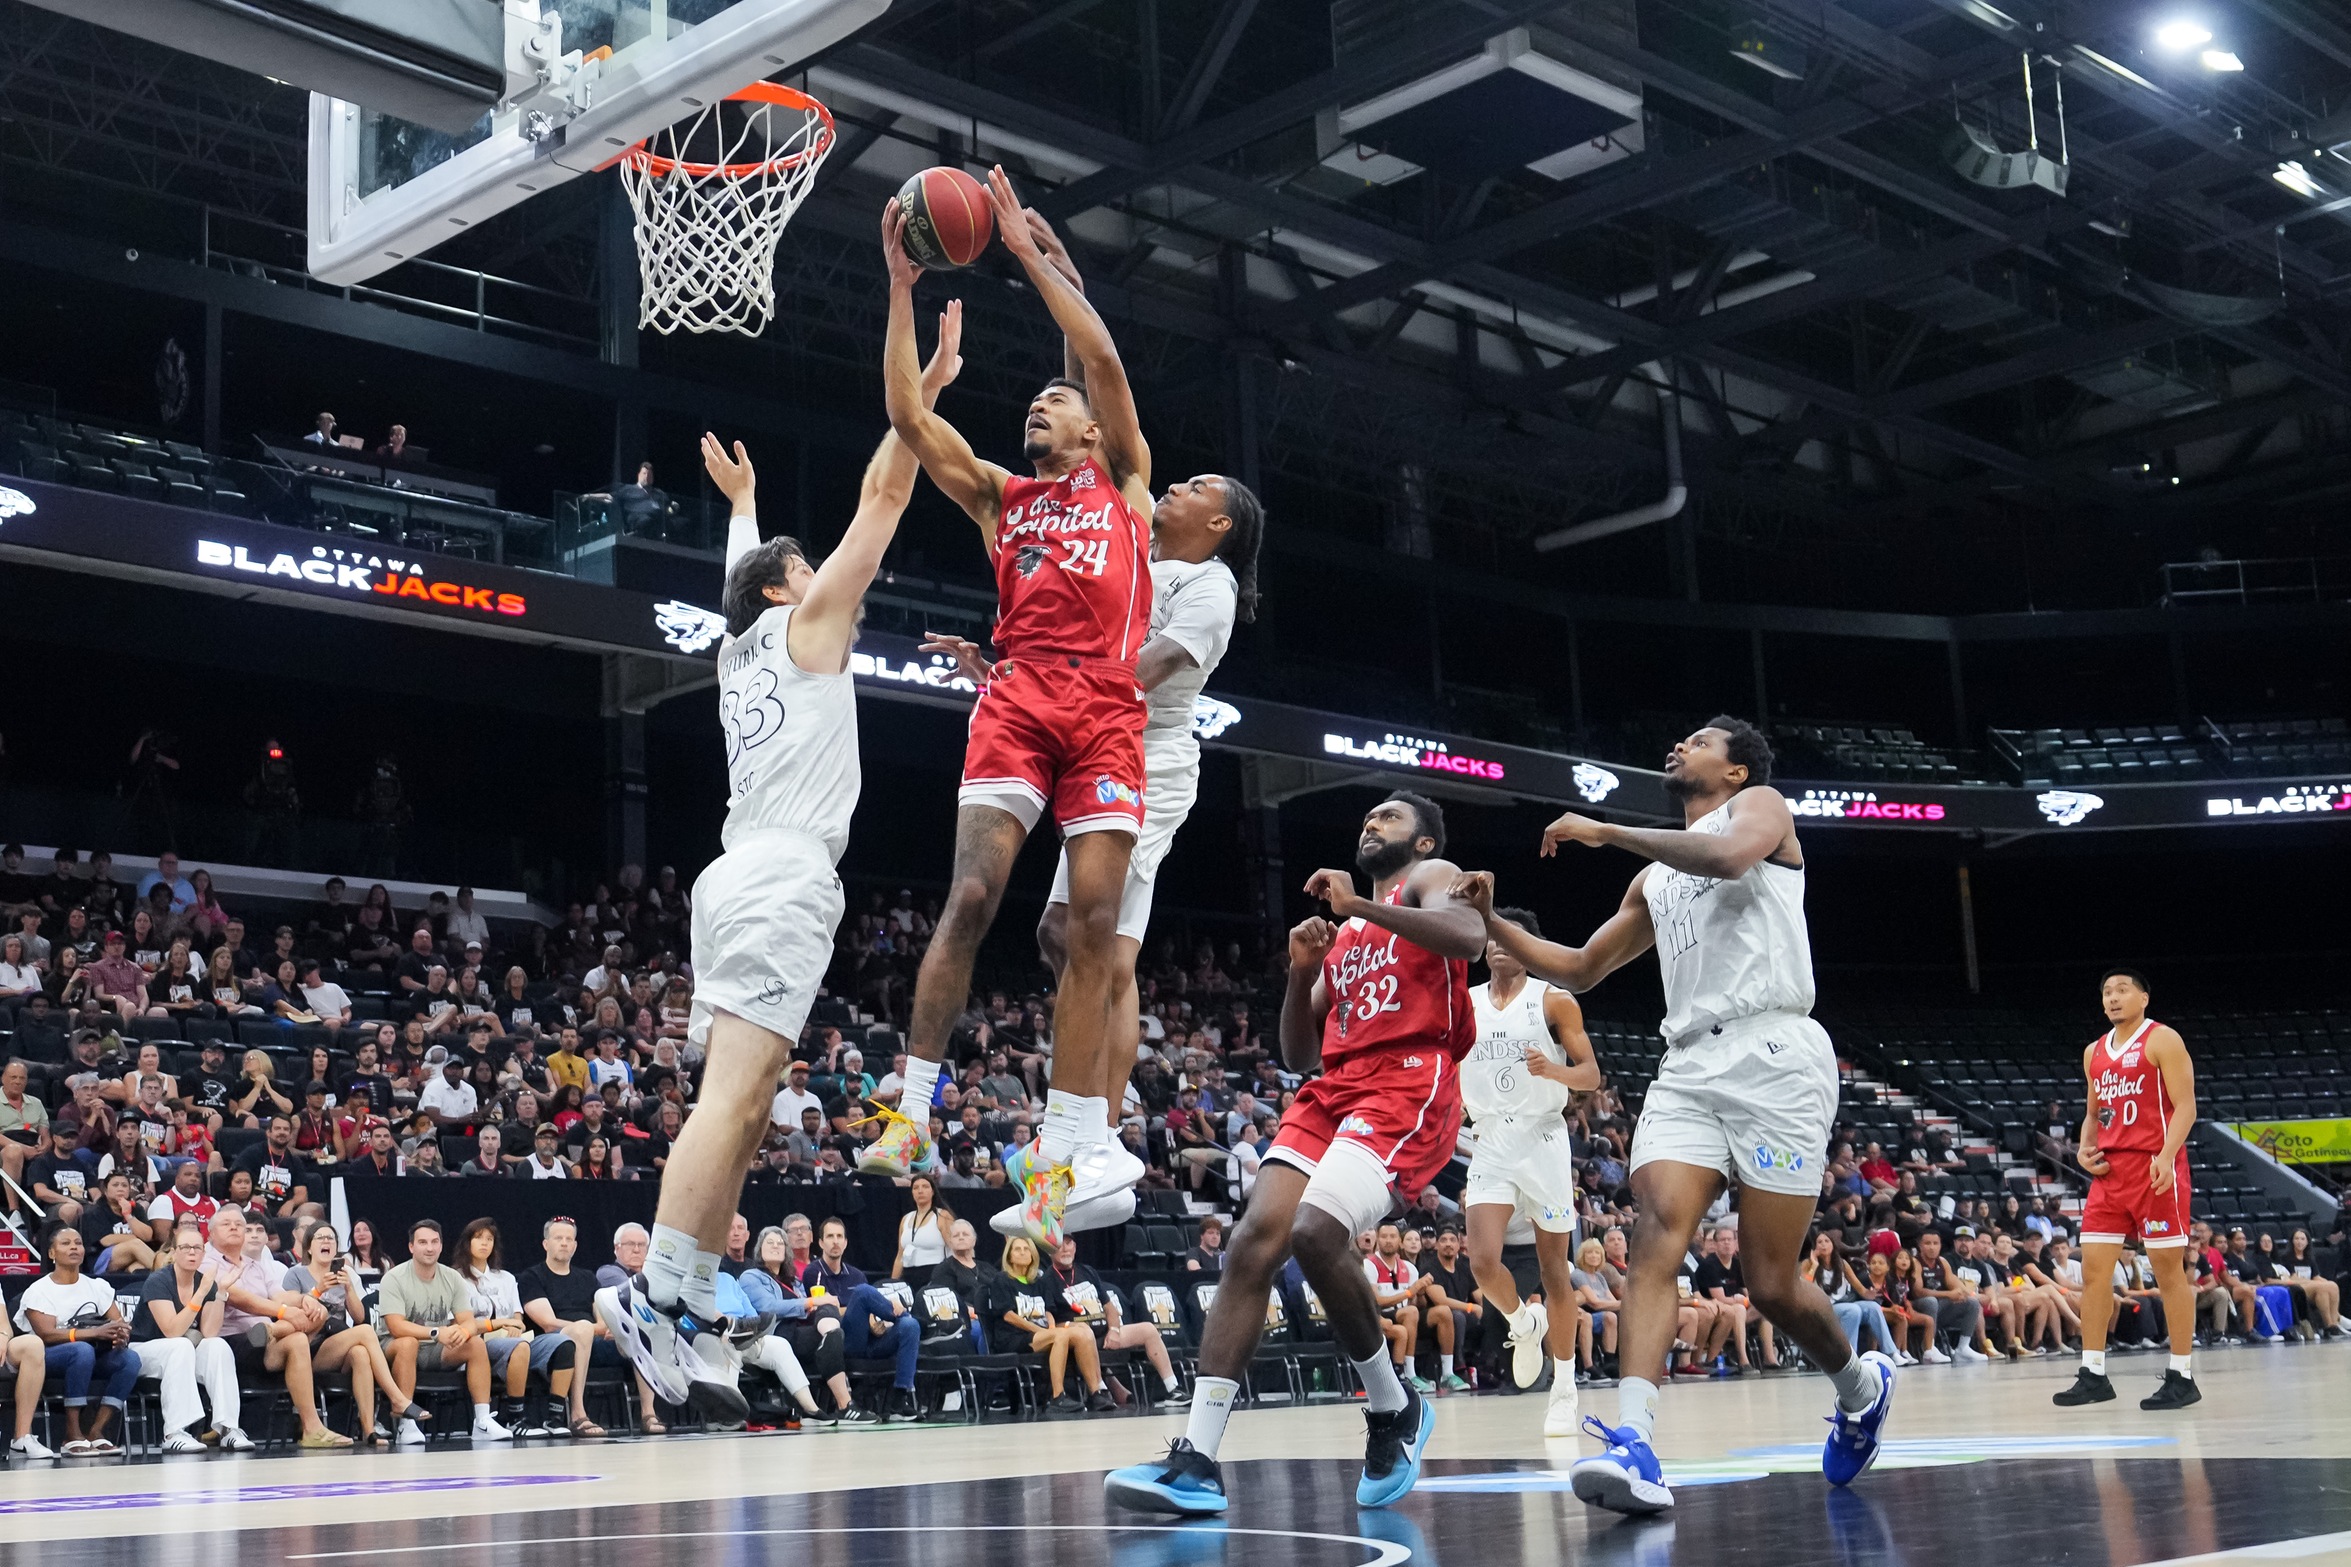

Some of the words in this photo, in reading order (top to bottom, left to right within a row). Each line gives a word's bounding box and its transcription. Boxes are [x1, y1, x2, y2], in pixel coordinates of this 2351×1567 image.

[902, 191, 937, 260] SPALDING
[1029, 491, 1062, 517] the
[1002, 502, 1114, 544] Capital
[312, 546, 424, 575] OTTAWA
[1059, 539, 1109, 576] 24
[197, 539, 527, 617] BLACKJACKS
[722, 667, 785, 770] 33
[1324, 733, 1505, 780] BLACKJACKS
[1384, 733, 1448, 753] OTTAWA
[1092, 774, 1110, 786] Lotto
[1096, 780, 1140, 808] MAX
[1805, 789, 1877, 802] OTTAWA
[1668, 908, 1699, 962] 11
[1357, 974, 1401, 1021] 32
[1491, 1031, 1508, 1039] THE
[1494, 1066, 1516, 1093] 6
[2093, 1074, 2146, 1106] Capital
[2101, 1068, 2119, 1085] the
[2122, 1099, 2138, 1126] 0
[1752, 1145, 1803, 1174] MAX
[1543, 1206, 1570, 1220] MAX
[2144, 1220, 2169, 1235] MAX
